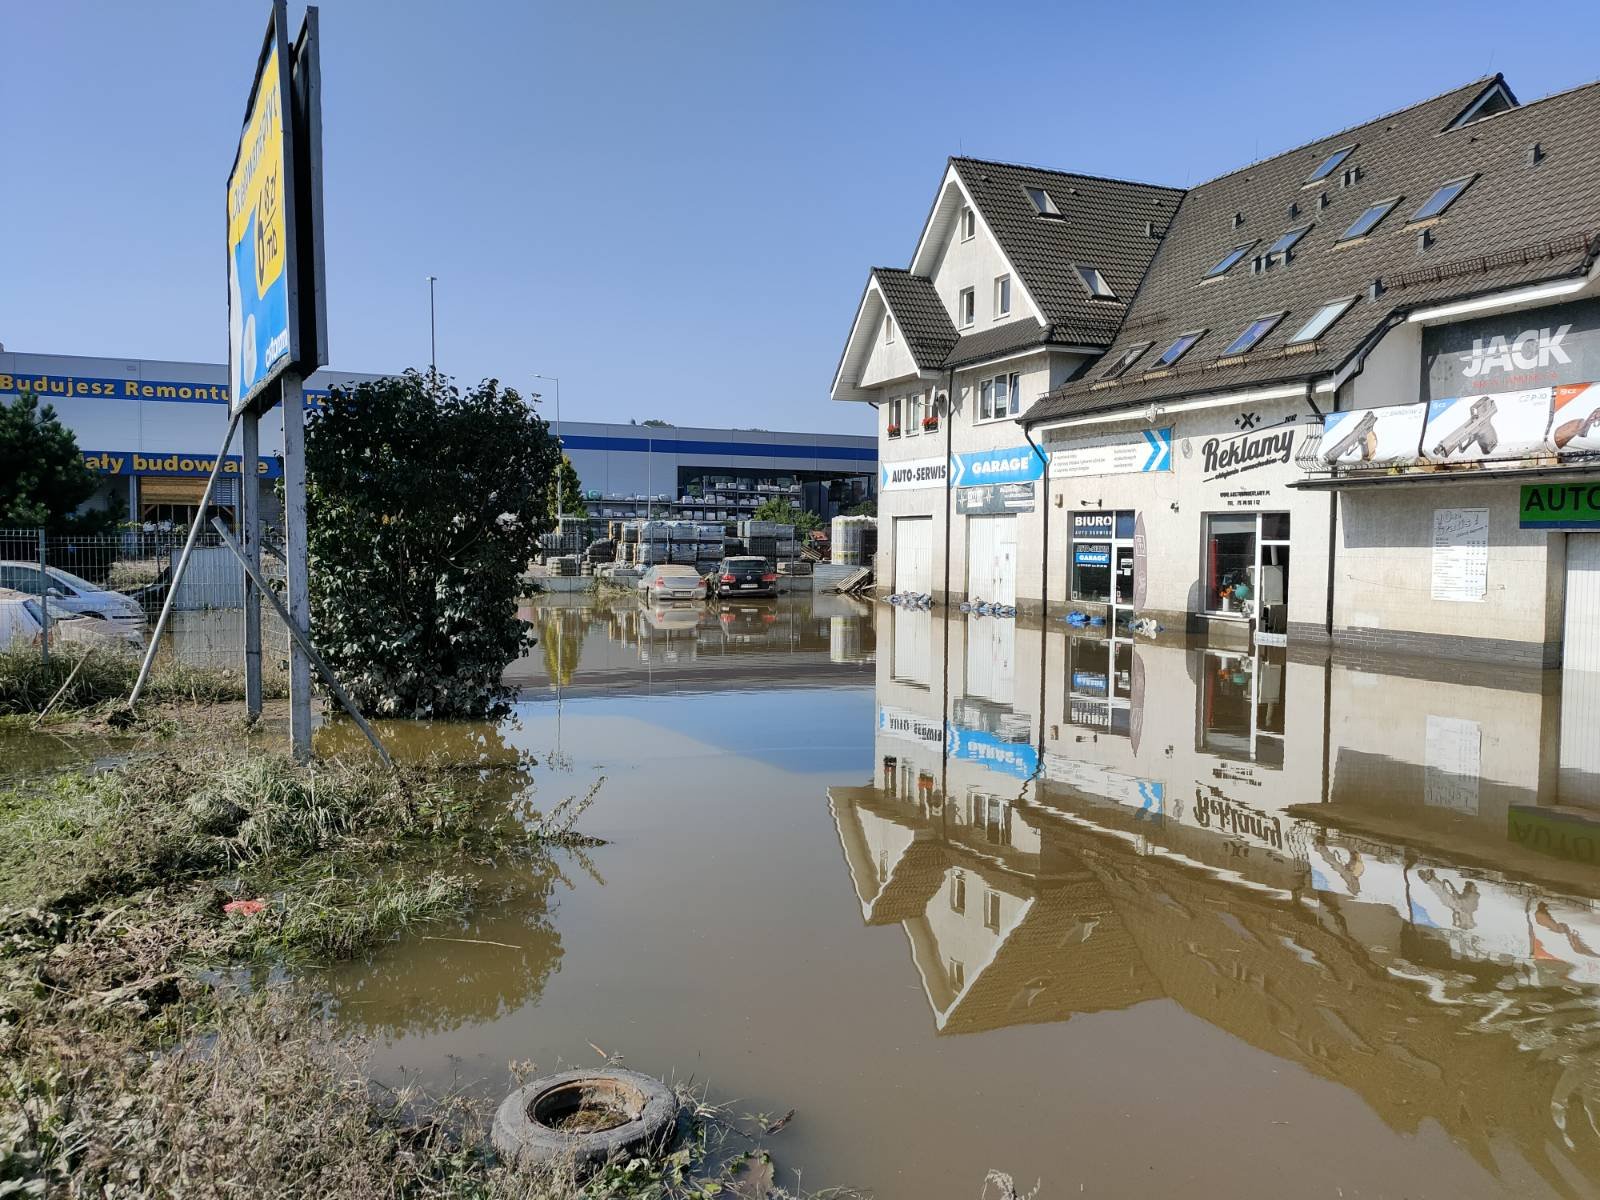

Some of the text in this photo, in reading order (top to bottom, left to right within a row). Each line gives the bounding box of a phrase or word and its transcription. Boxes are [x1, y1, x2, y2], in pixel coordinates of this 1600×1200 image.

[1460, 324, 1573, 377] JACK
[0, 374, 115, 397] Budujesz
[1201, 429, 1295, 473] Reklamy
[1075, 515, 1113, 527] BIURO
